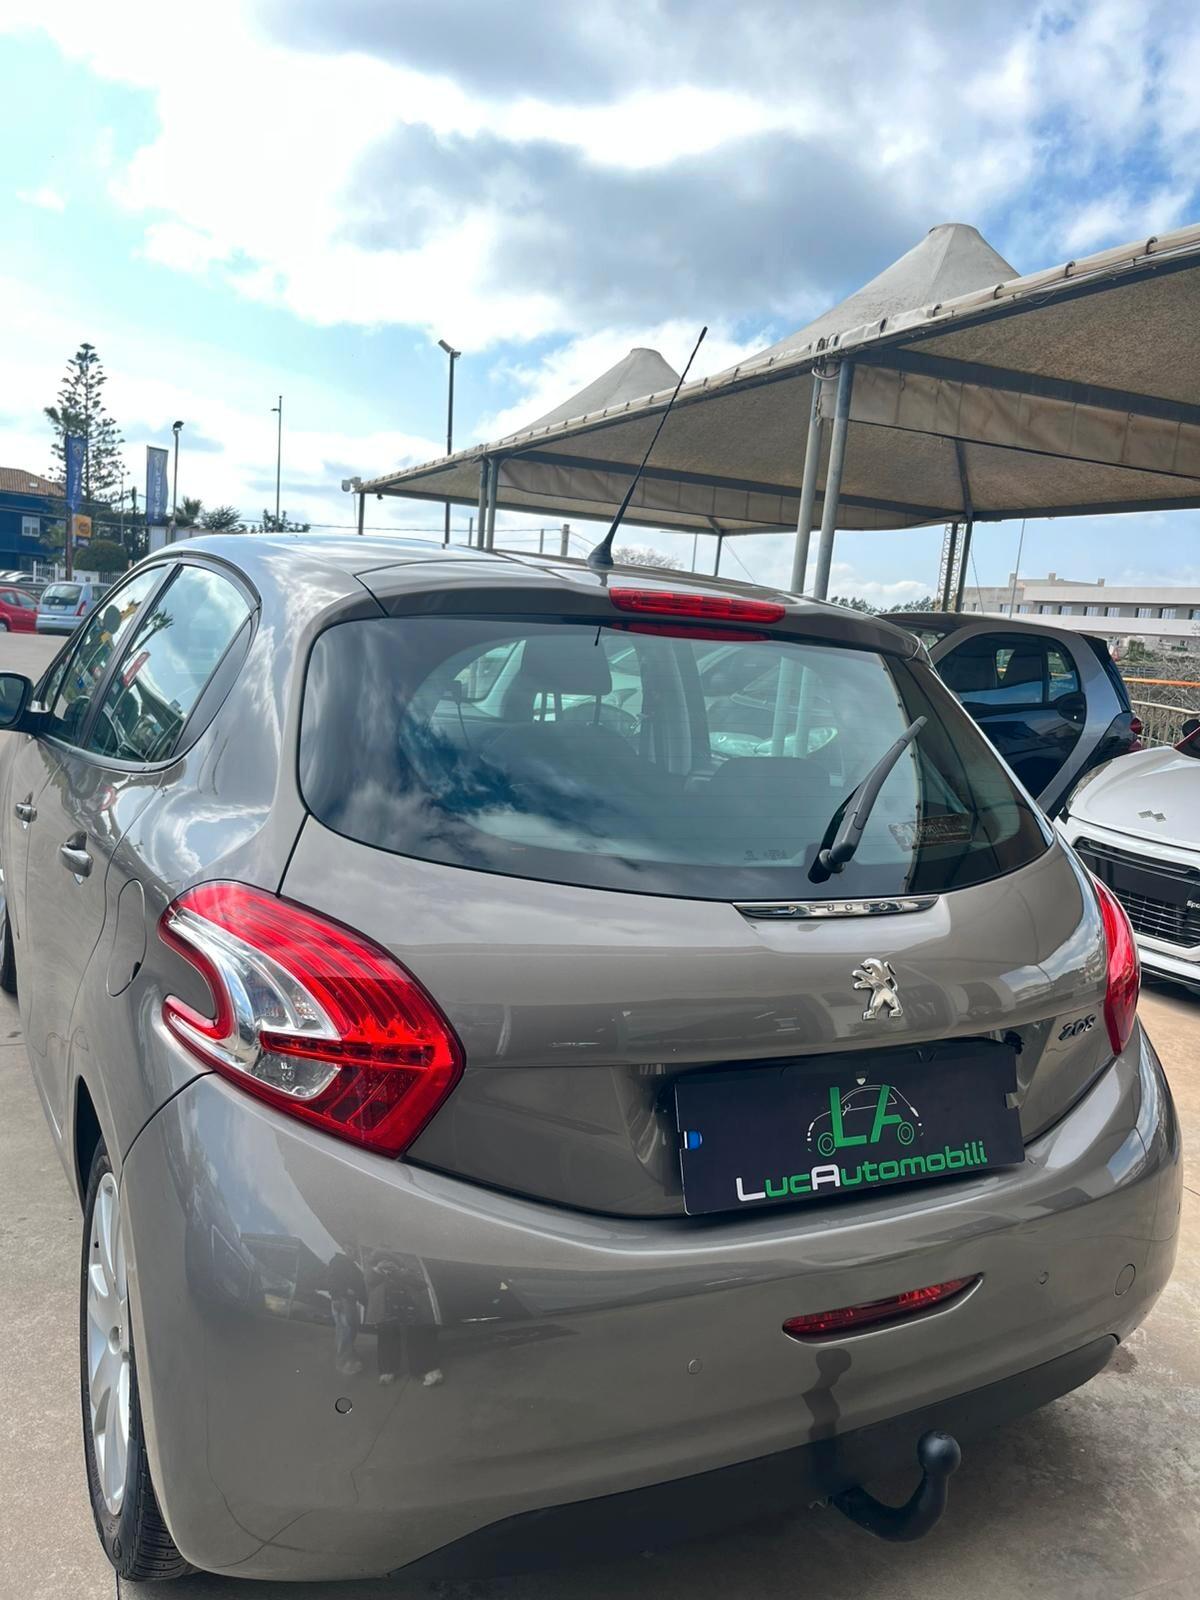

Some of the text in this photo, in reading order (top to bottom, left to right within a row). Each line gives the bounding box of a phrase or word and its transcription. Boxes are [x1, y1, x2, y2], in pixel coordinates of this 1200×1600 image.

[1057, 1013, 1097, 1041] 208
[829, 1084, 903, 1148] LA
[735, 1140, 989, 1203] LucAutomobili
